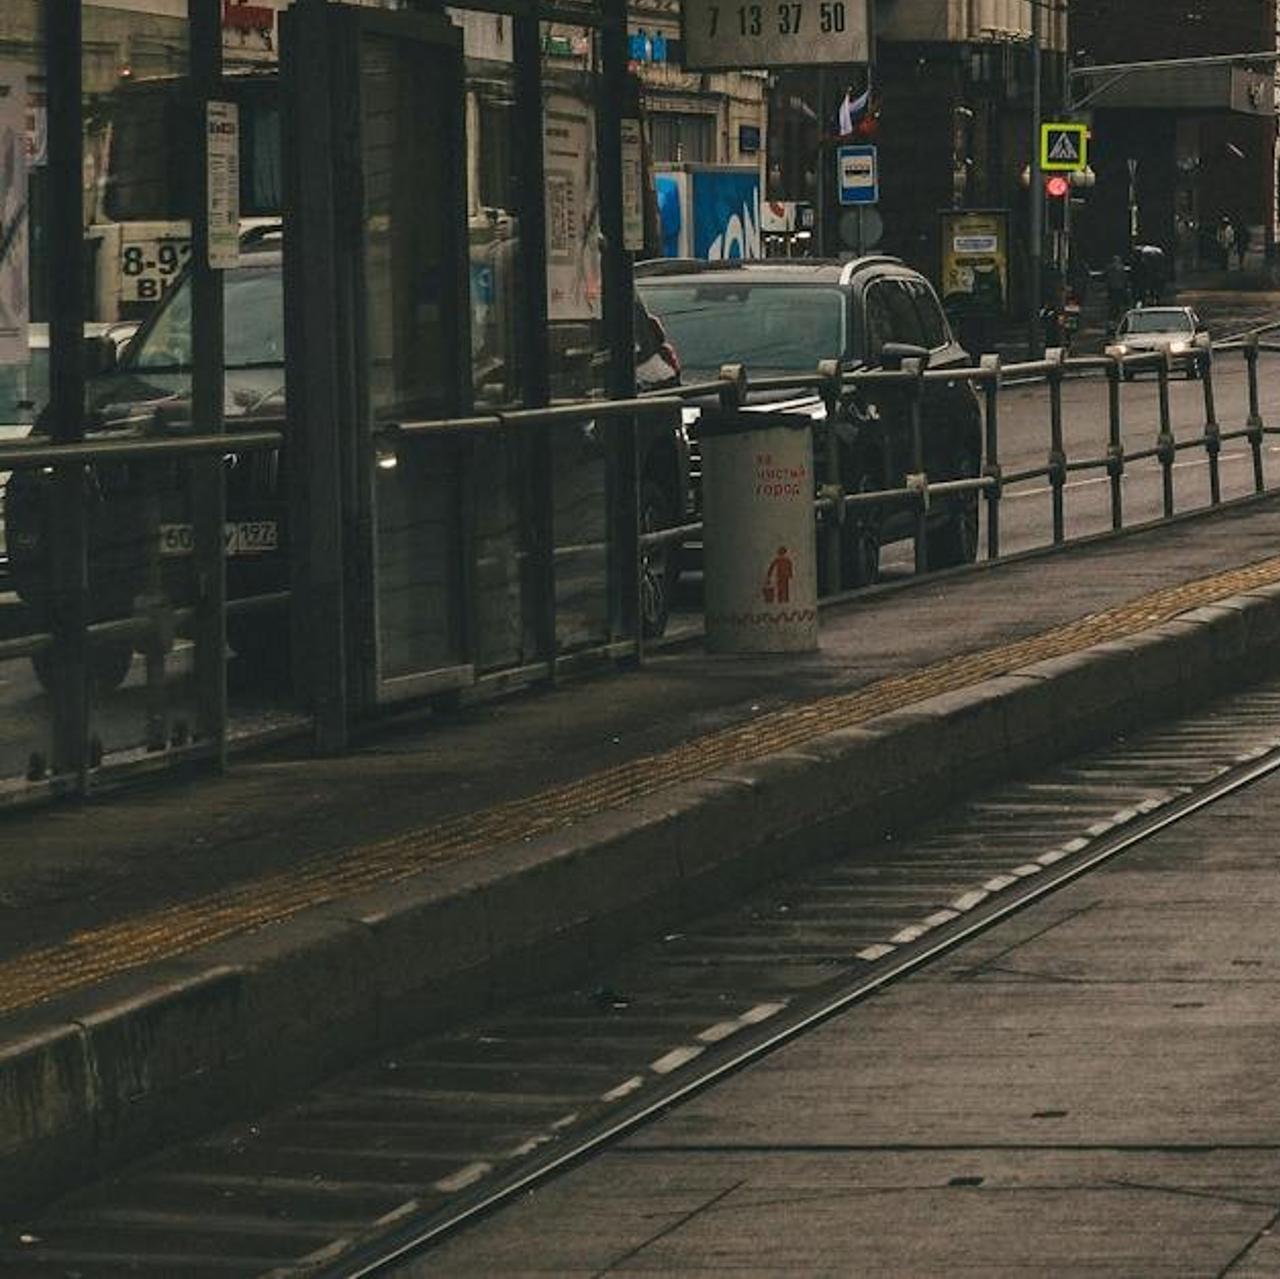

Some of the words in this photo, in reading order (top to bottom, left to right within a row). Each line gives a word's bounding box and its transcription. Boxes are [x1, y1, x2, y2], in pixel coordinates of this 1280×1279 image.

[708, 6, 719, 38] 7
[737, 5, 762, 36] 13
[778, 4, 802, 34] 37
[821, 2, 845, 33] 50
